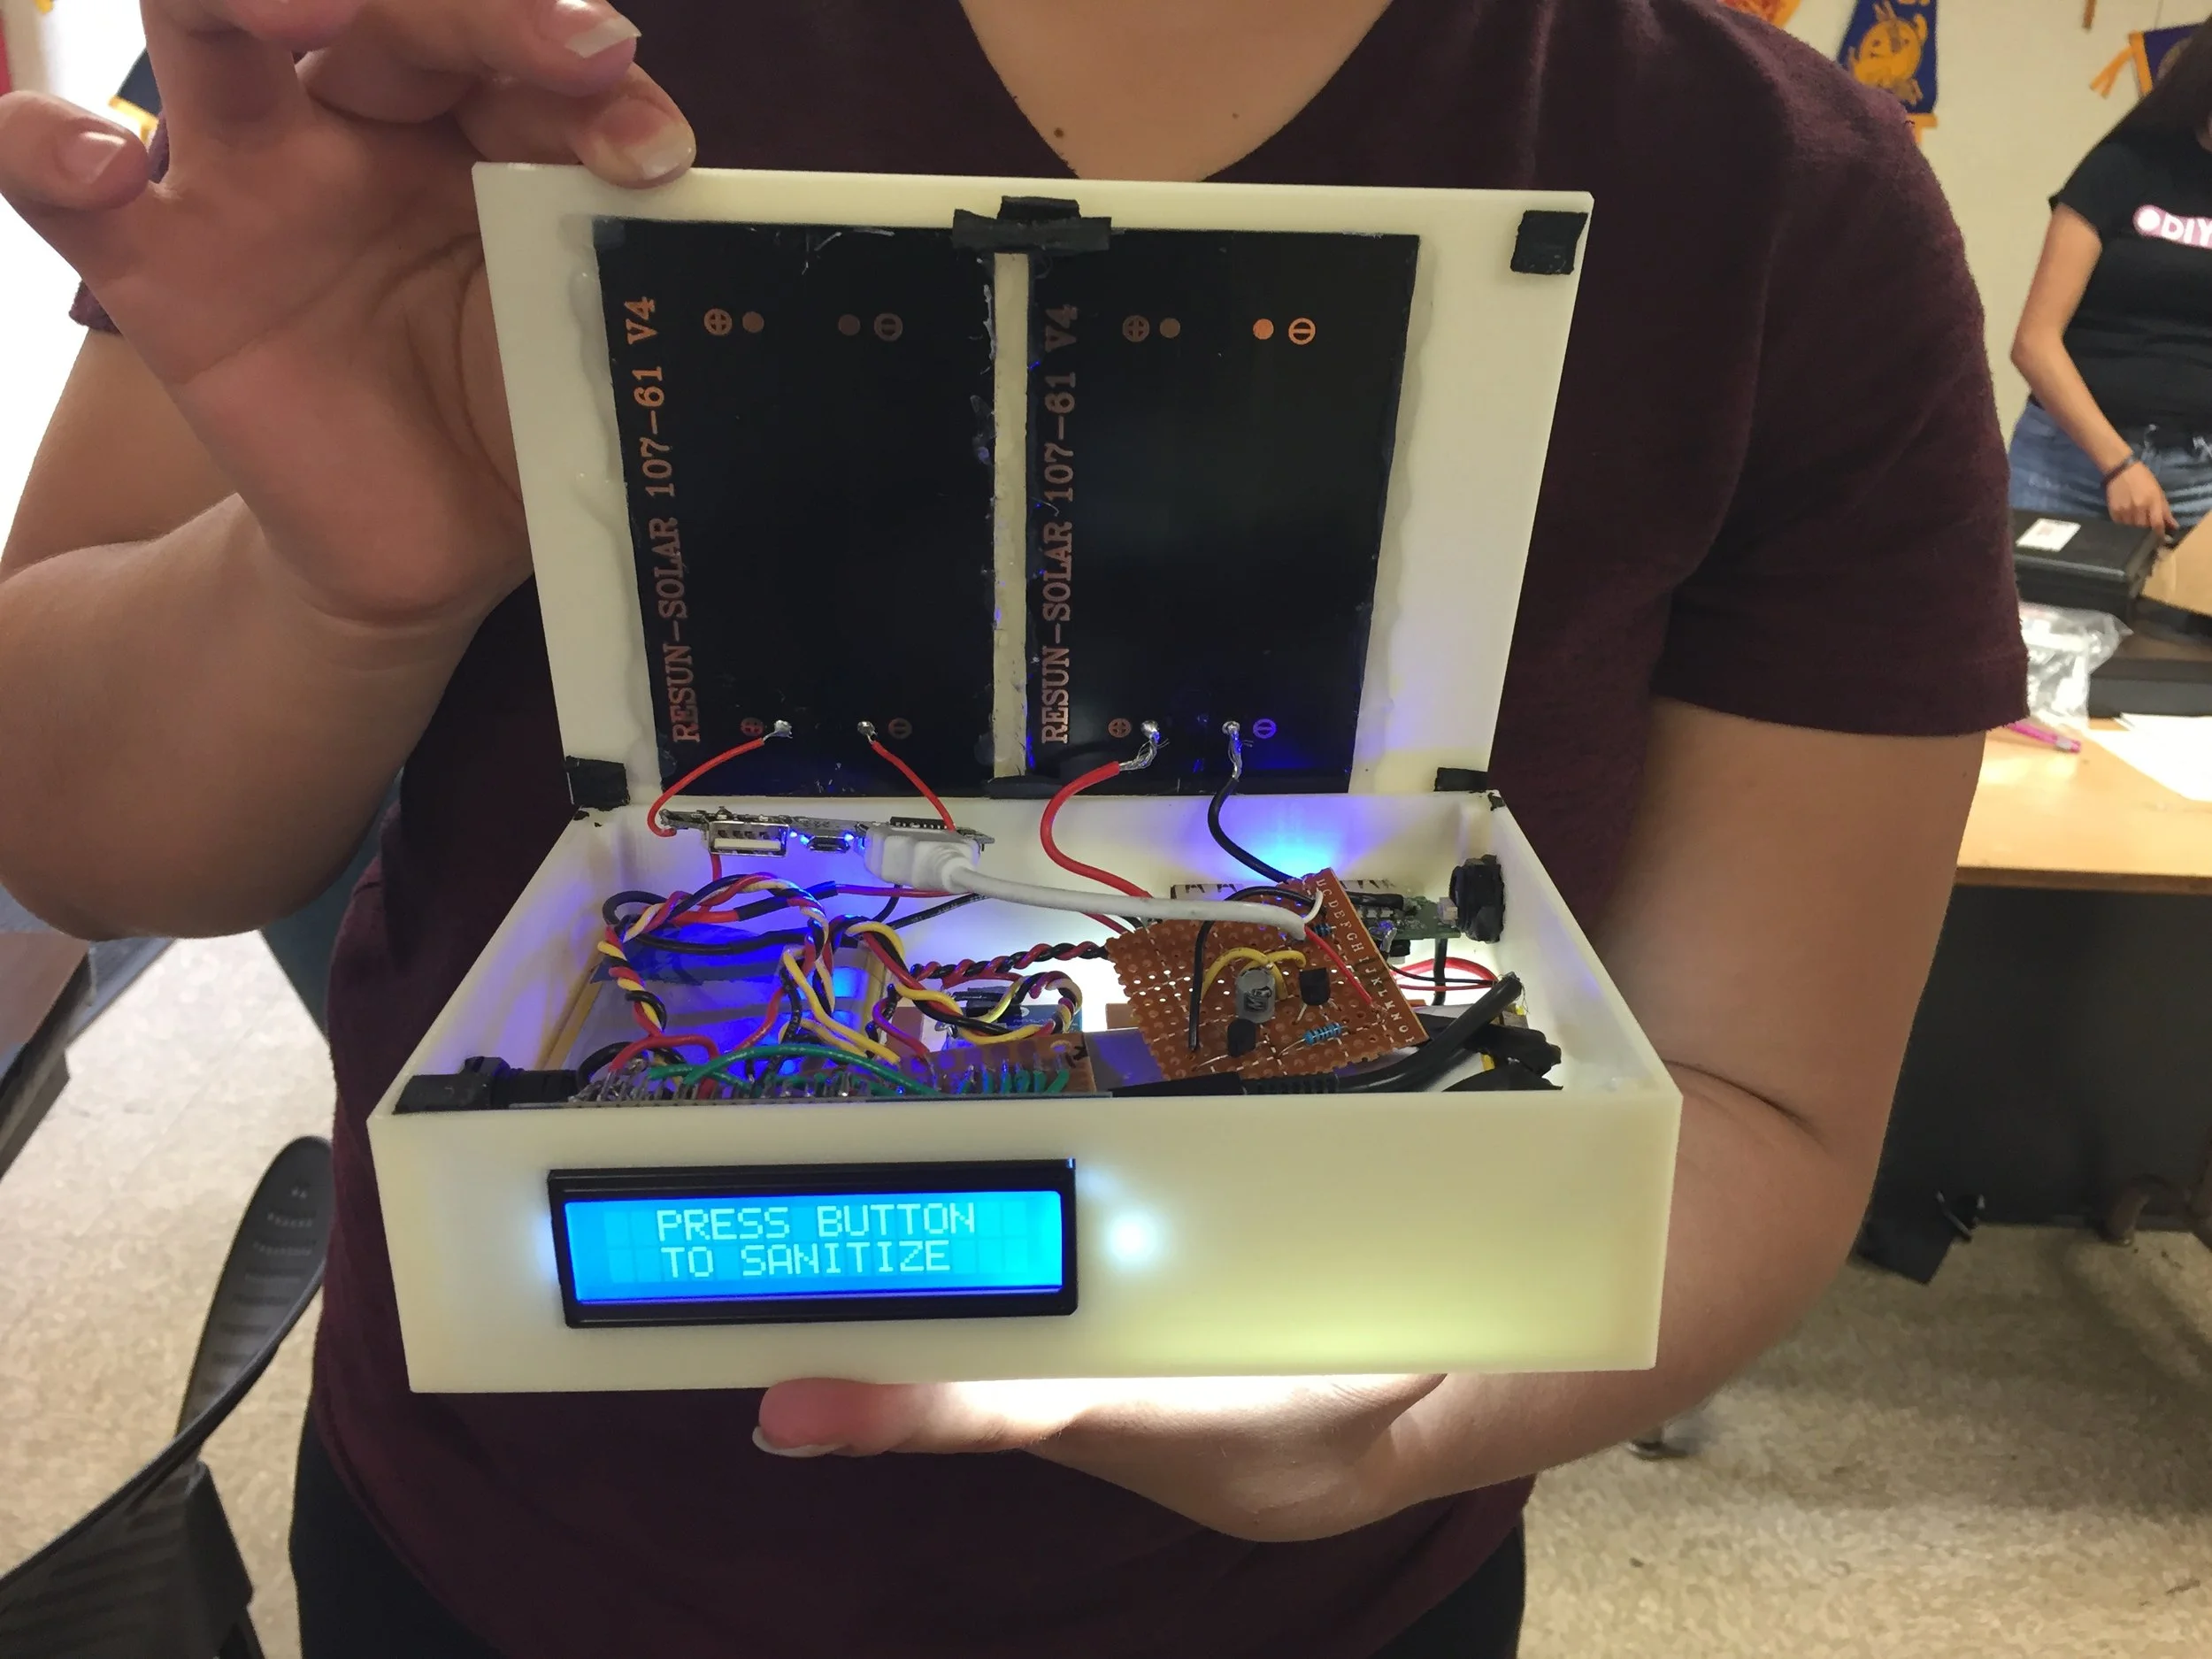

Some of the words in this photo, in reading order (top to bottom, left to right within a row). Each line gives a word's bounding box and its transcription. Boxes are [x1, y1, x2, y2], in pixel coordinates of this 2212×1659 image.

[2161, 212, 2212, 247] DIY
[625, 296, 658, 345] V4
[1045, 304, 1078, 352] V4
[632, 365, 675, 497] 107-61
[1044, 372, 1077, 503] 107-61
[649, 517, 700, 743] RESUN-SOLAR
[1041, 520, 1073, 744] RESUN-SOLAR
[1333, 910, 1345, 918] E
[1351, 942, 1364, 952] H
[657, 1206, 790, 1241] PRESS
[818, 1202, 975, 1238] BUTTON
[661, 1246, 713, 1279] TO
[741, 1240, 950, 1277] SANITIZE
